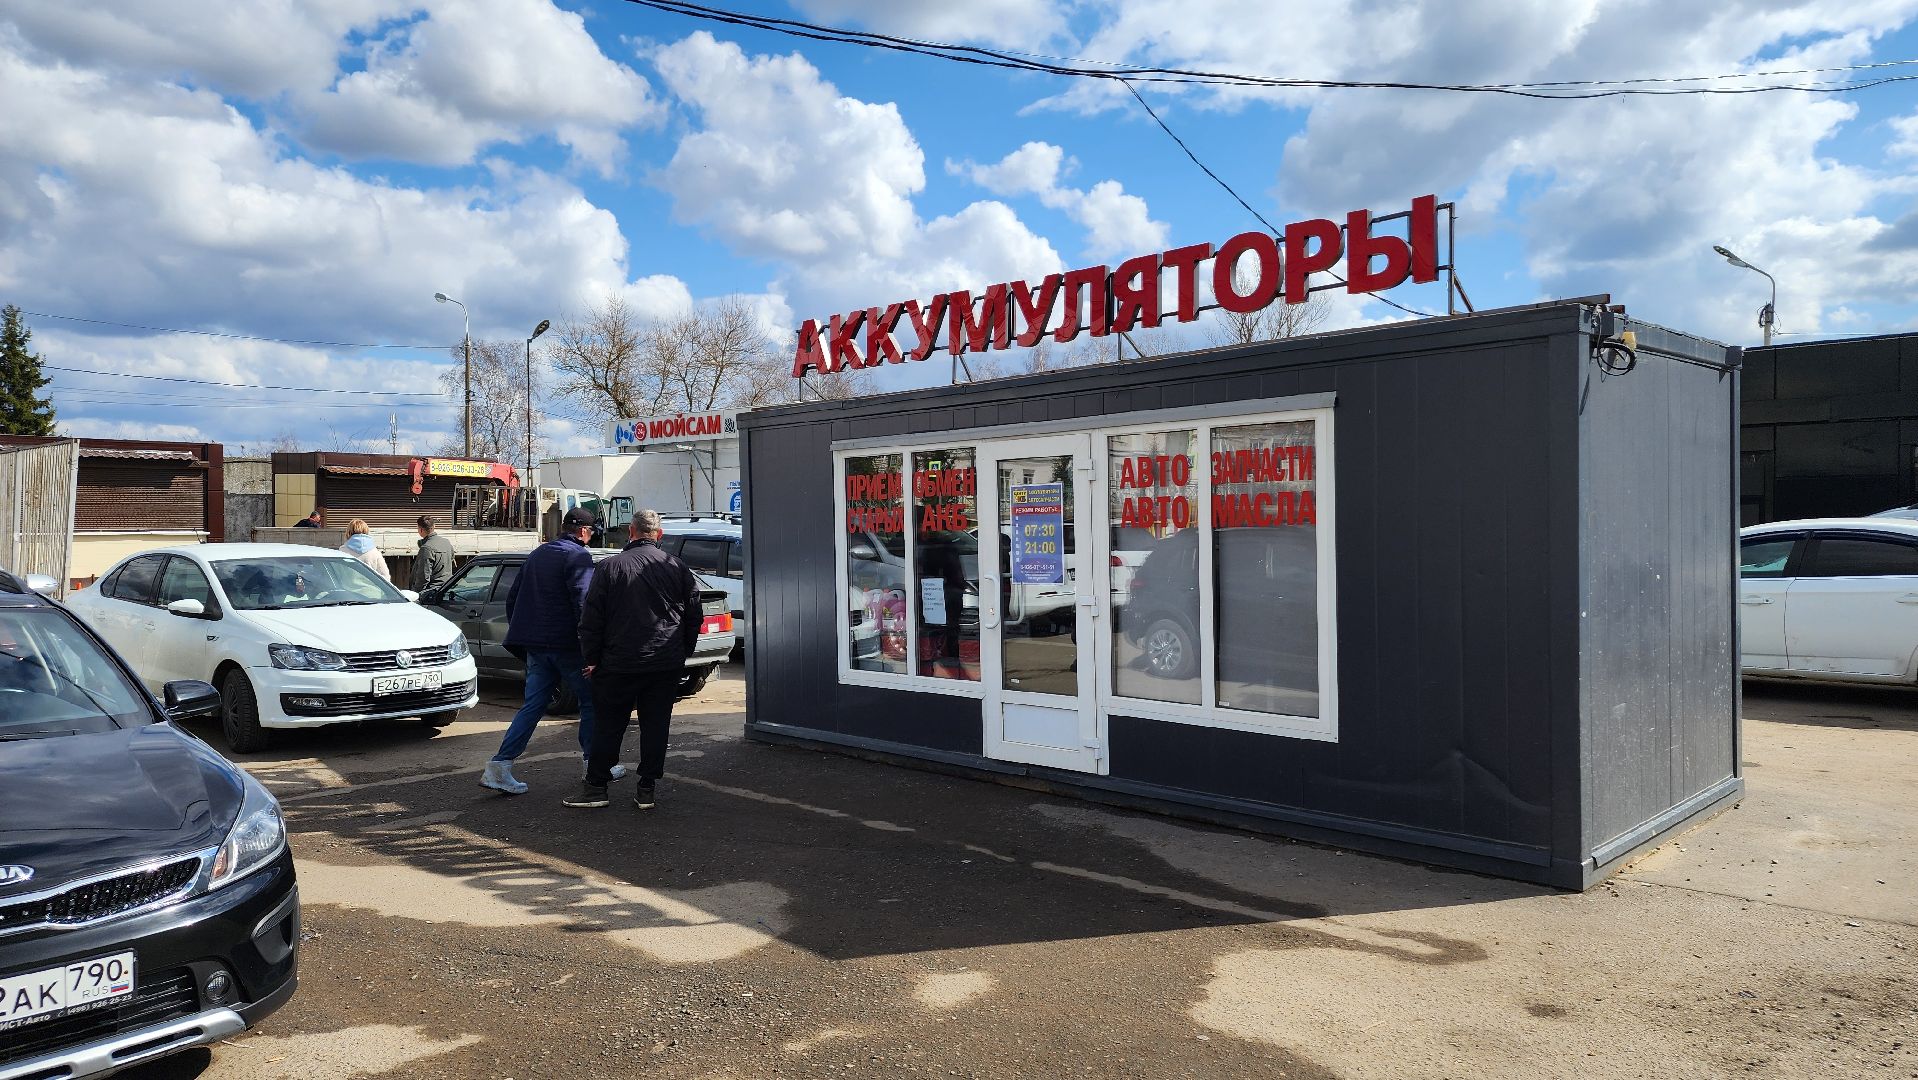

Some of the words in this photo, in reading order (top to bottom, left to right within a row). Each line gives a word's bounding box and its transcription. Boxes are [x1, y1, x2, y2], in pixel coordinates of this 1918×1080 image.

[793, 194, 1440, 378] АККУМУЛЯТОРЫ
[649, 413, 722, 439] МОЙСАМ
[1120, 455, 1190, 489] АВТО
[1211, 445, 1314, 486] ЗАПЧАСТИ
[847, 473, 902, 500] ПРИЕМ
[915, 468, 975, 497] ОБМЕН
[847, 505, 905, 535] СТАРЫХ
[921, 502, 969, 532] АКБ
[1120, 495, 1190, 529] АВТО
[1211, 490, 1315, 528] МАСЛА
[1024, 524, 1055, 537] 07:30
[1024, 541, 1056, 554] 21:00
[378, 677, 422, 692] Е267РЕ
[69, 958, 123, 992] 790
[82, 985, 109, 999] RUS
